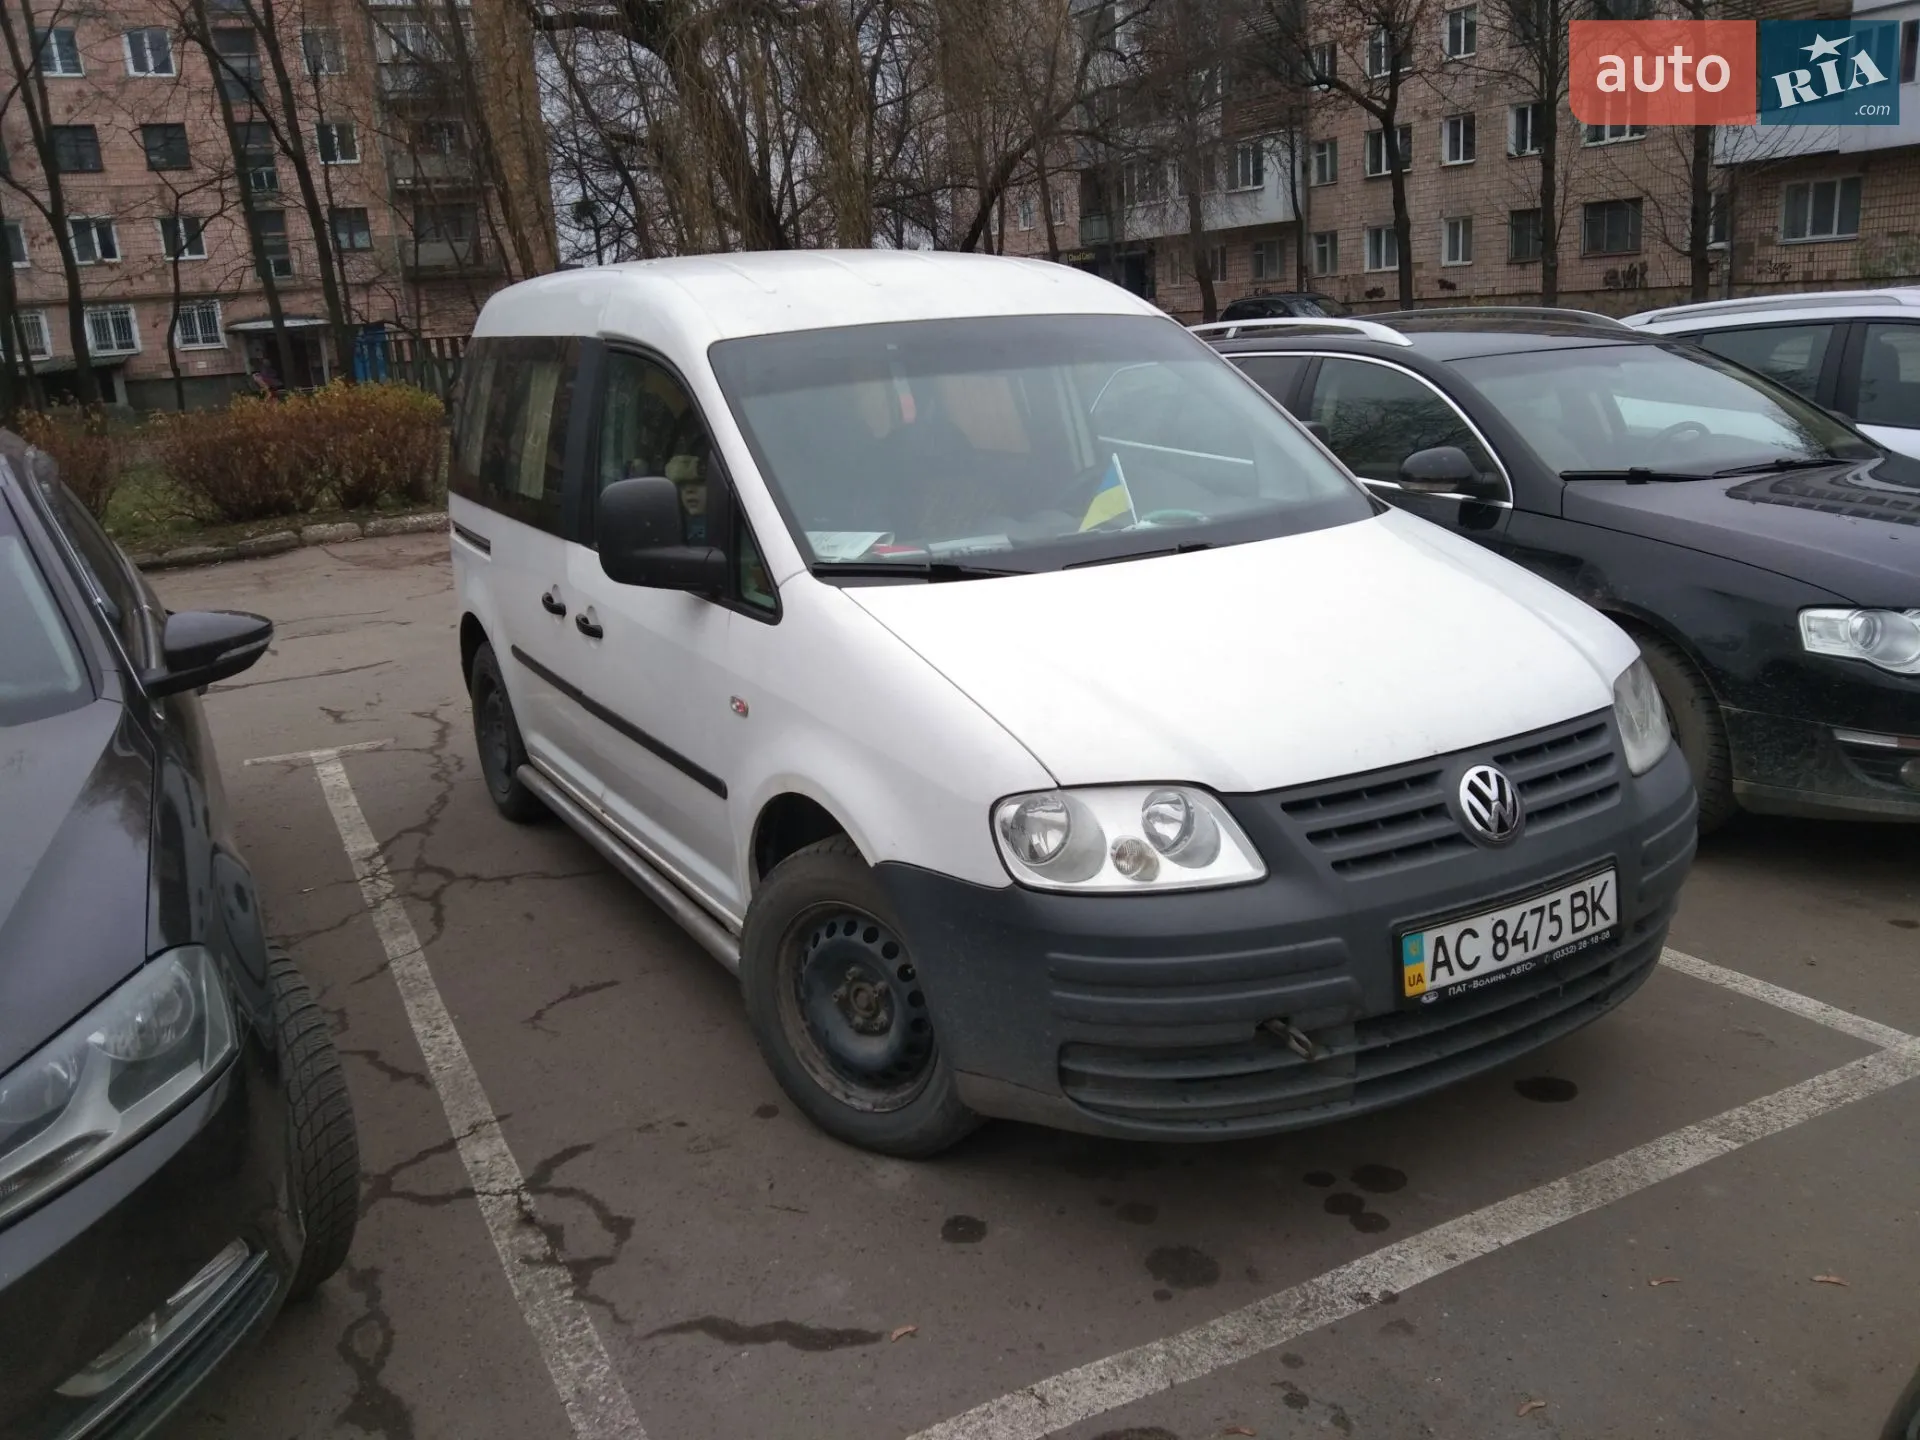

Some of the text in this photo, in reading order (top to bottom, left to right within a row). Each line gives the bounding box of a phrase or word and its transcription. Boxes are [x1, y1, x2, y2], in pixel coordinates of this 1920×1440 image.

[1430, 880, 1611, 982] AC 8475 BK
[1407, 973, 1424, 988] UA
[1448, 983, 1467, 996] ПАТ
